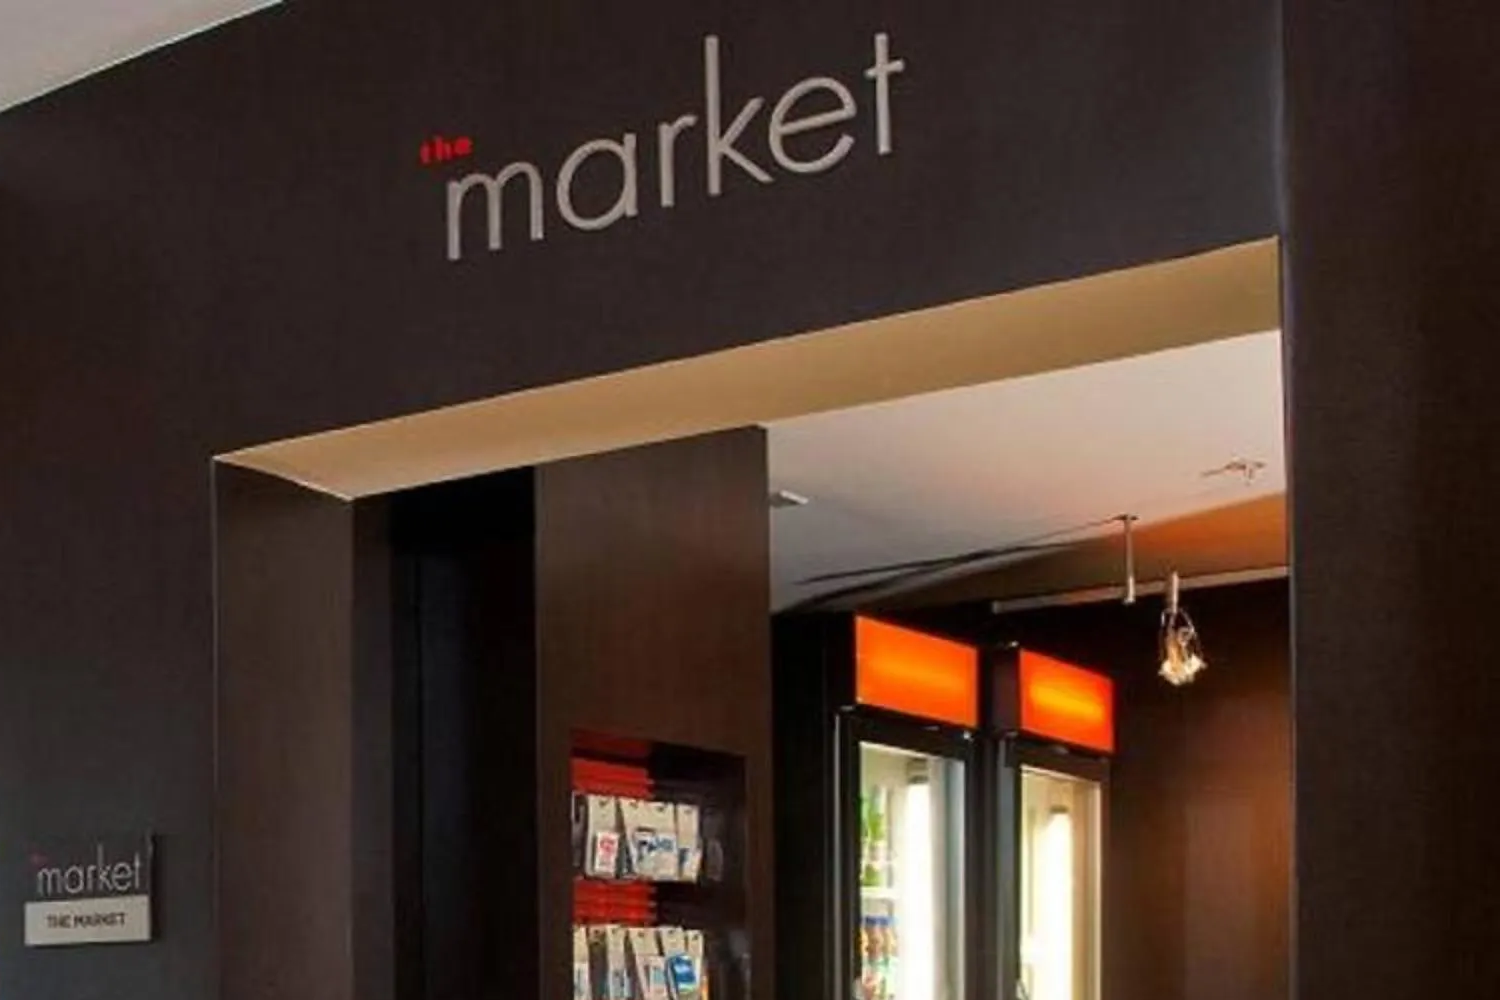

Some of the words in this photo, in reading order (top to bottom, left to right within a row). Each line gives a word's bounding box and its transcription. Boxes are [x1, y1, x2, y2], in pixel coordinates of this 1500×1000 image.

[419, 135, 473, 165] the
[446, 32, 904, 261] market
[36, 843, 141, 896] market
